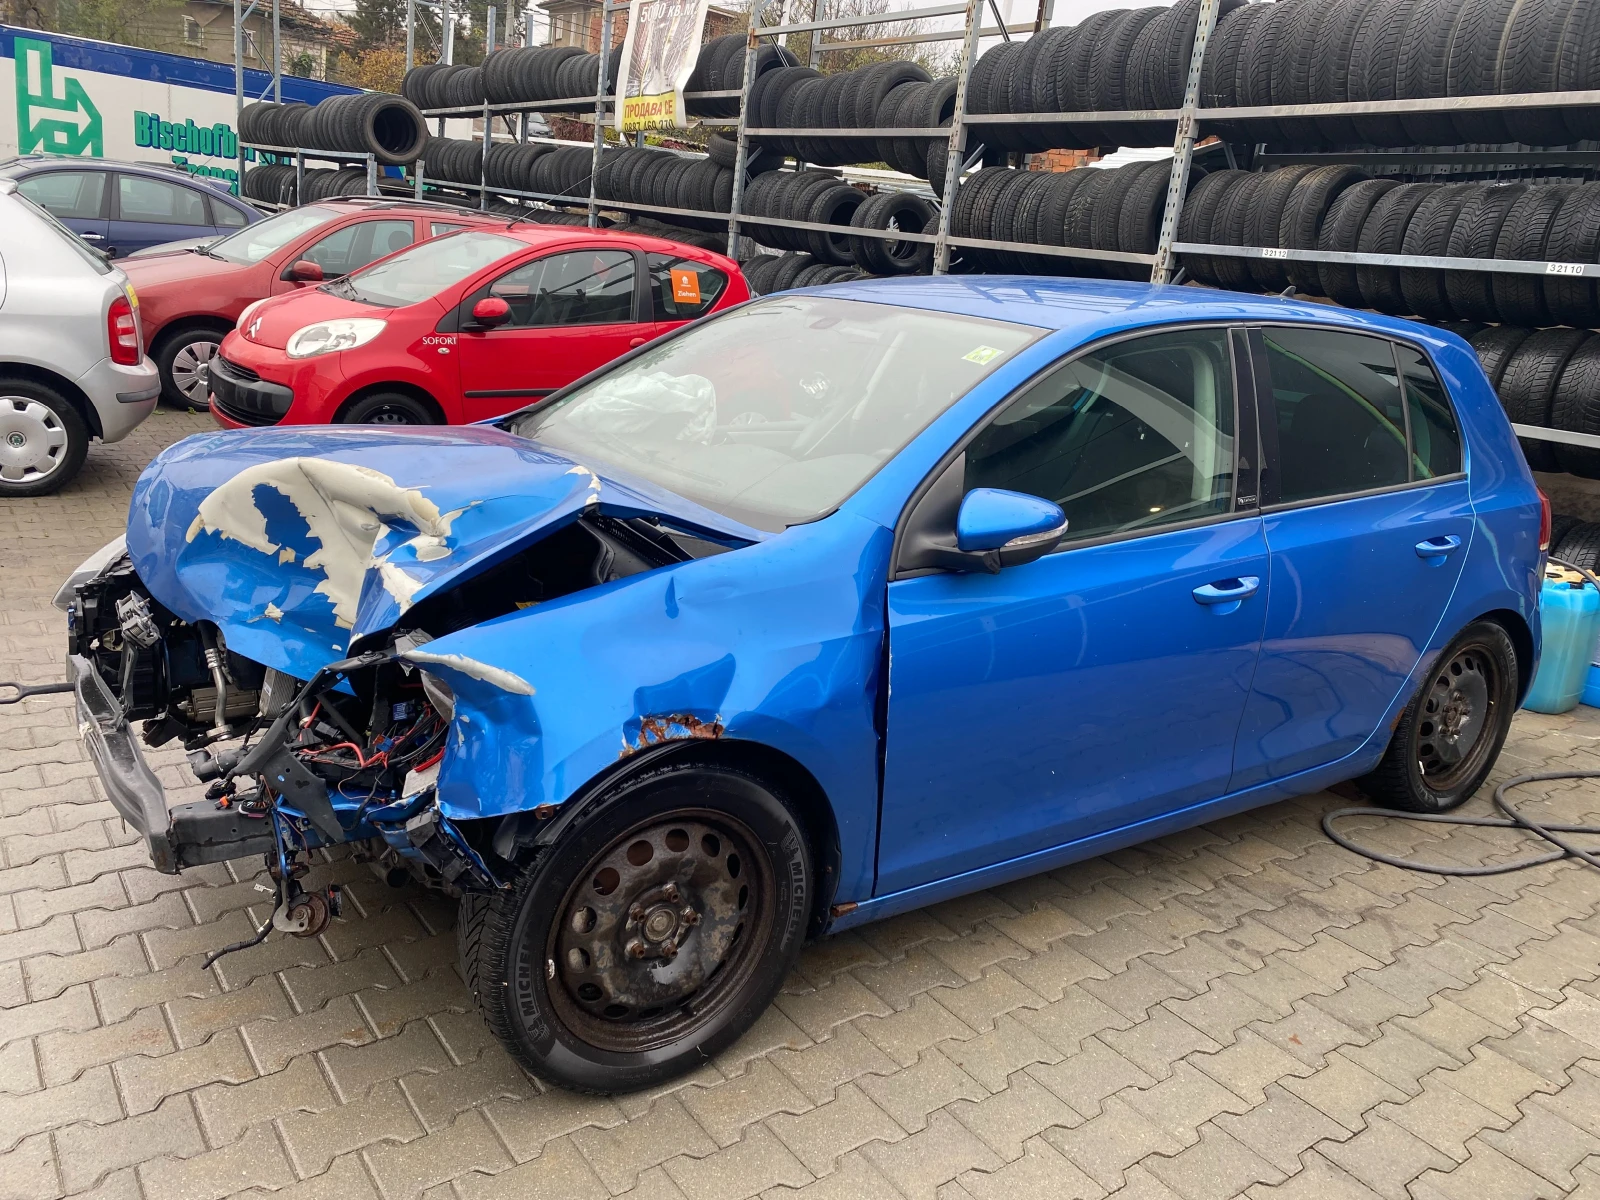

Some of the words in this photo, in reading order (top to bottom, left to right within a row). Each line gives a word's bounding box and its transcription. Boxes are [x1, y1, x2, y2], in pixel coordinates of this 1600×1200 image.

[640, 2, 667, 23] 5000
[624, 101, 663, 119] ПРОДАВА
[664, 99, 673, 115] СЕ
[624, 121, 641, 132] 0887
[134, 110, 291, 166] Bischofb
[677, 290, 697, 298] Ziehen
[422, 336, 457, 345] SOFORT
